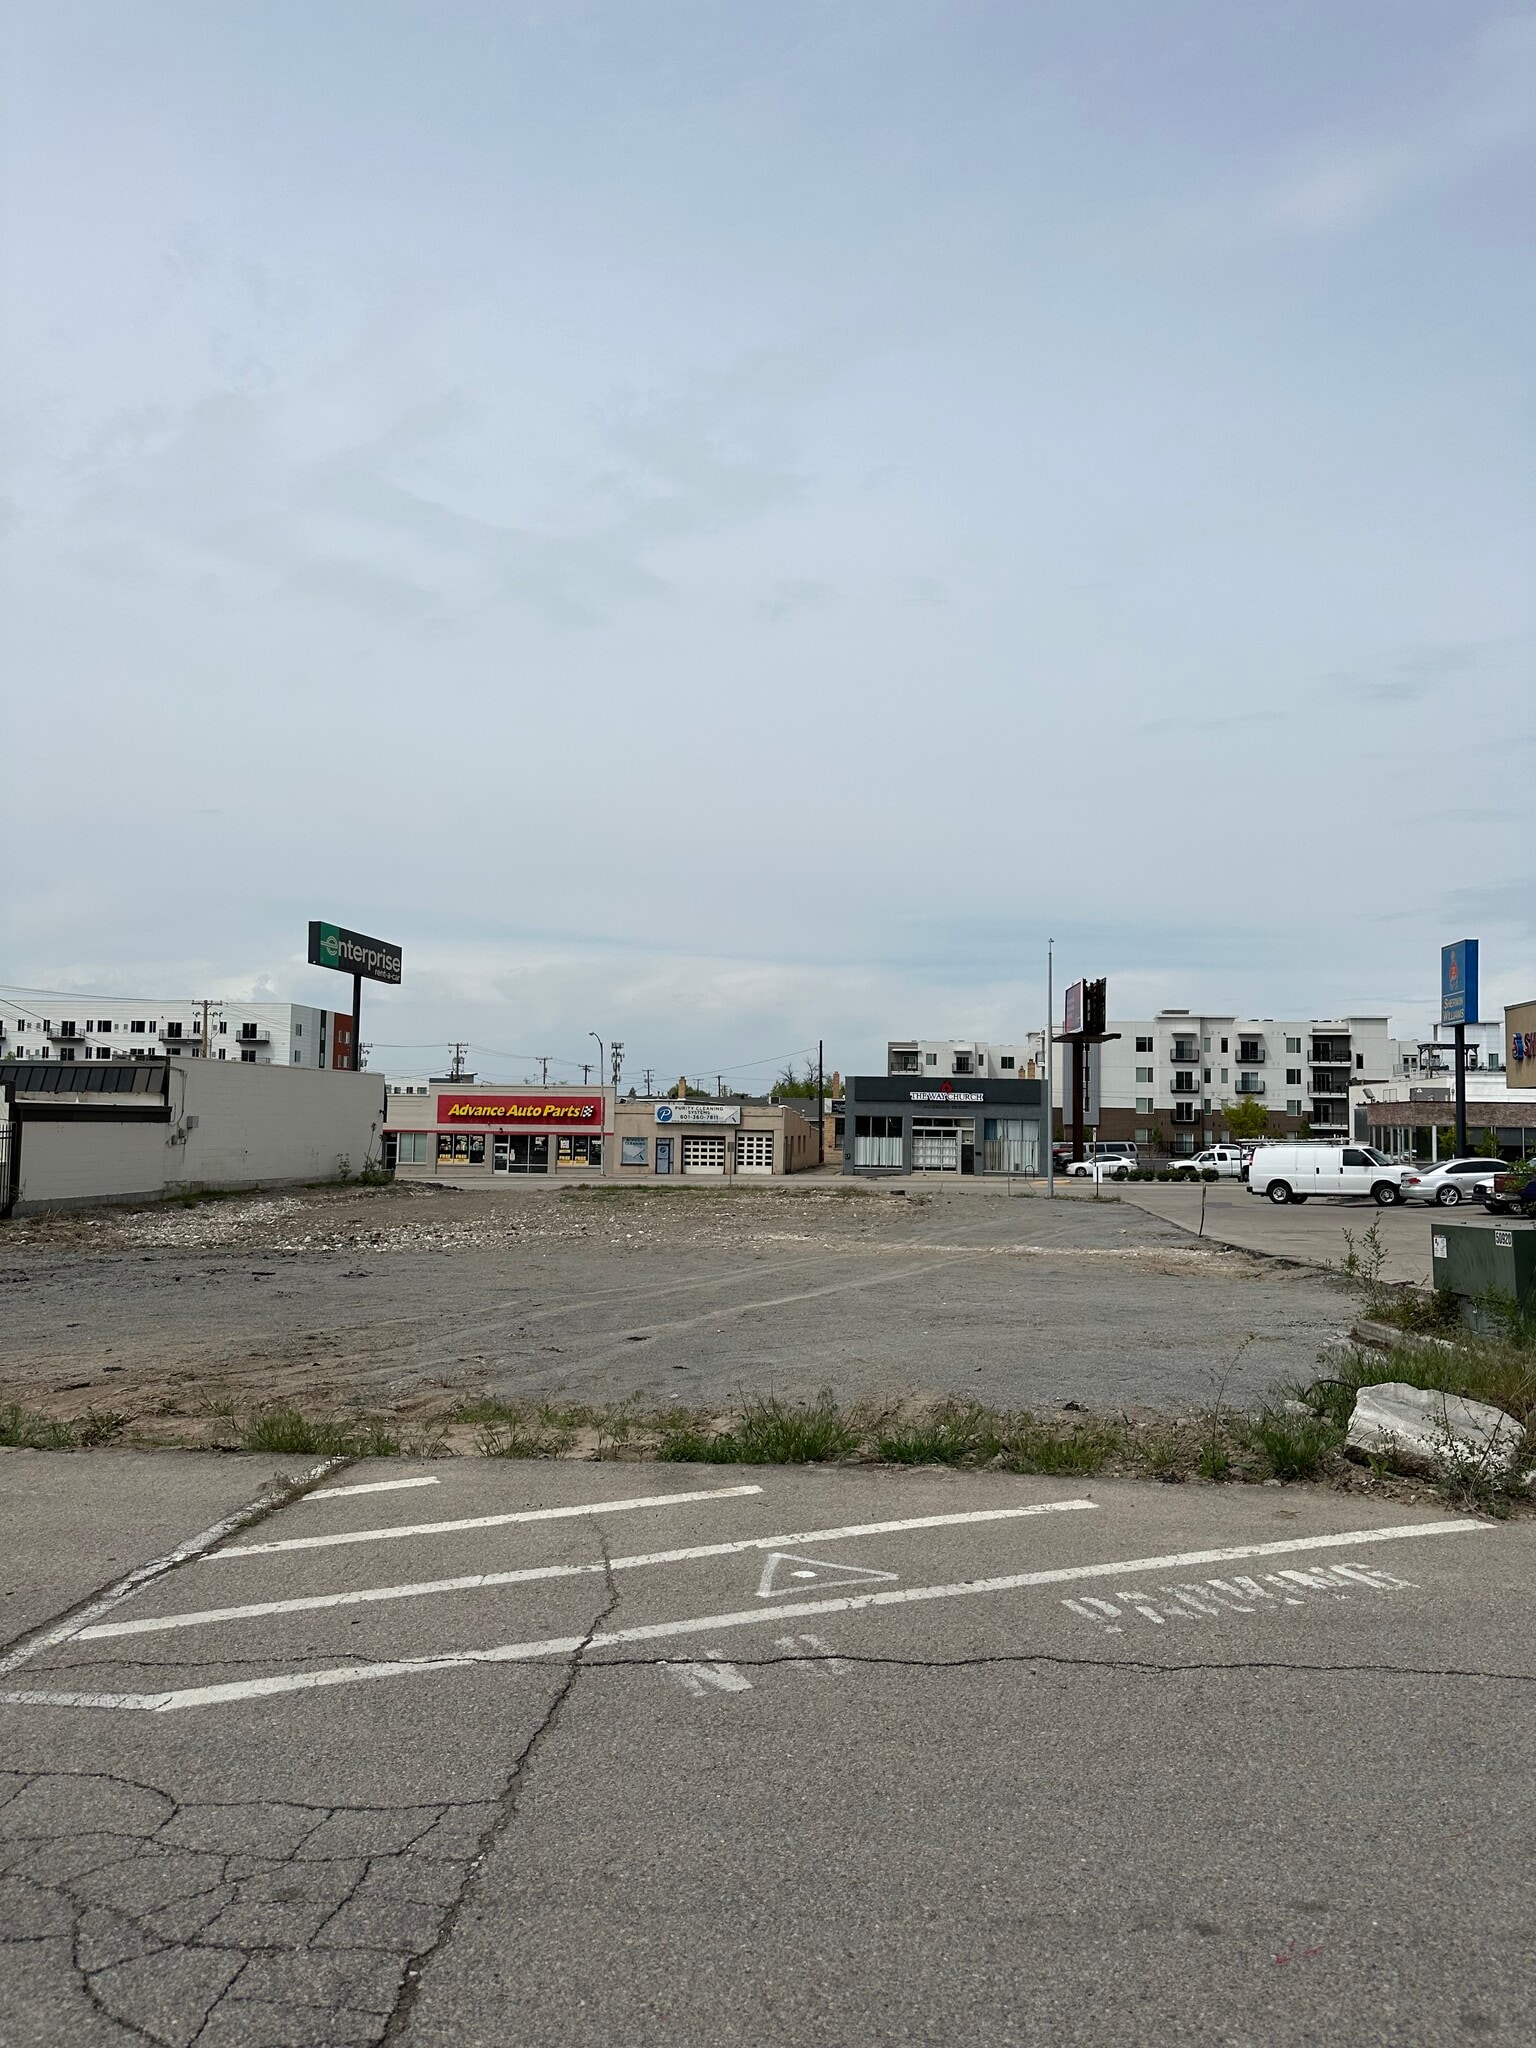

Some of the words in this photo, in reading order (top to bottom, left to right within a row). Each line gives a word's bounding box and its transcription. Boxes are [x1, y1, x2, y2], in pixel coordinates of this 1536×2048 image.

[320, 935, 401, 973] enterprise
[374, 969, 400, 982] rent-a-car
[1443, 1009, 1464, 1021] WILLIAMS
[910, 1092, 928, 1101] THE
[928, 1092, 947, 1101] WAY
[947, 1093, 984, 1102] CHURCH
[448, 1103, 505, 1117] Advance
[506, 1104, 542, 1117] Auto
[543, 1105, 580, 1117] Parts
